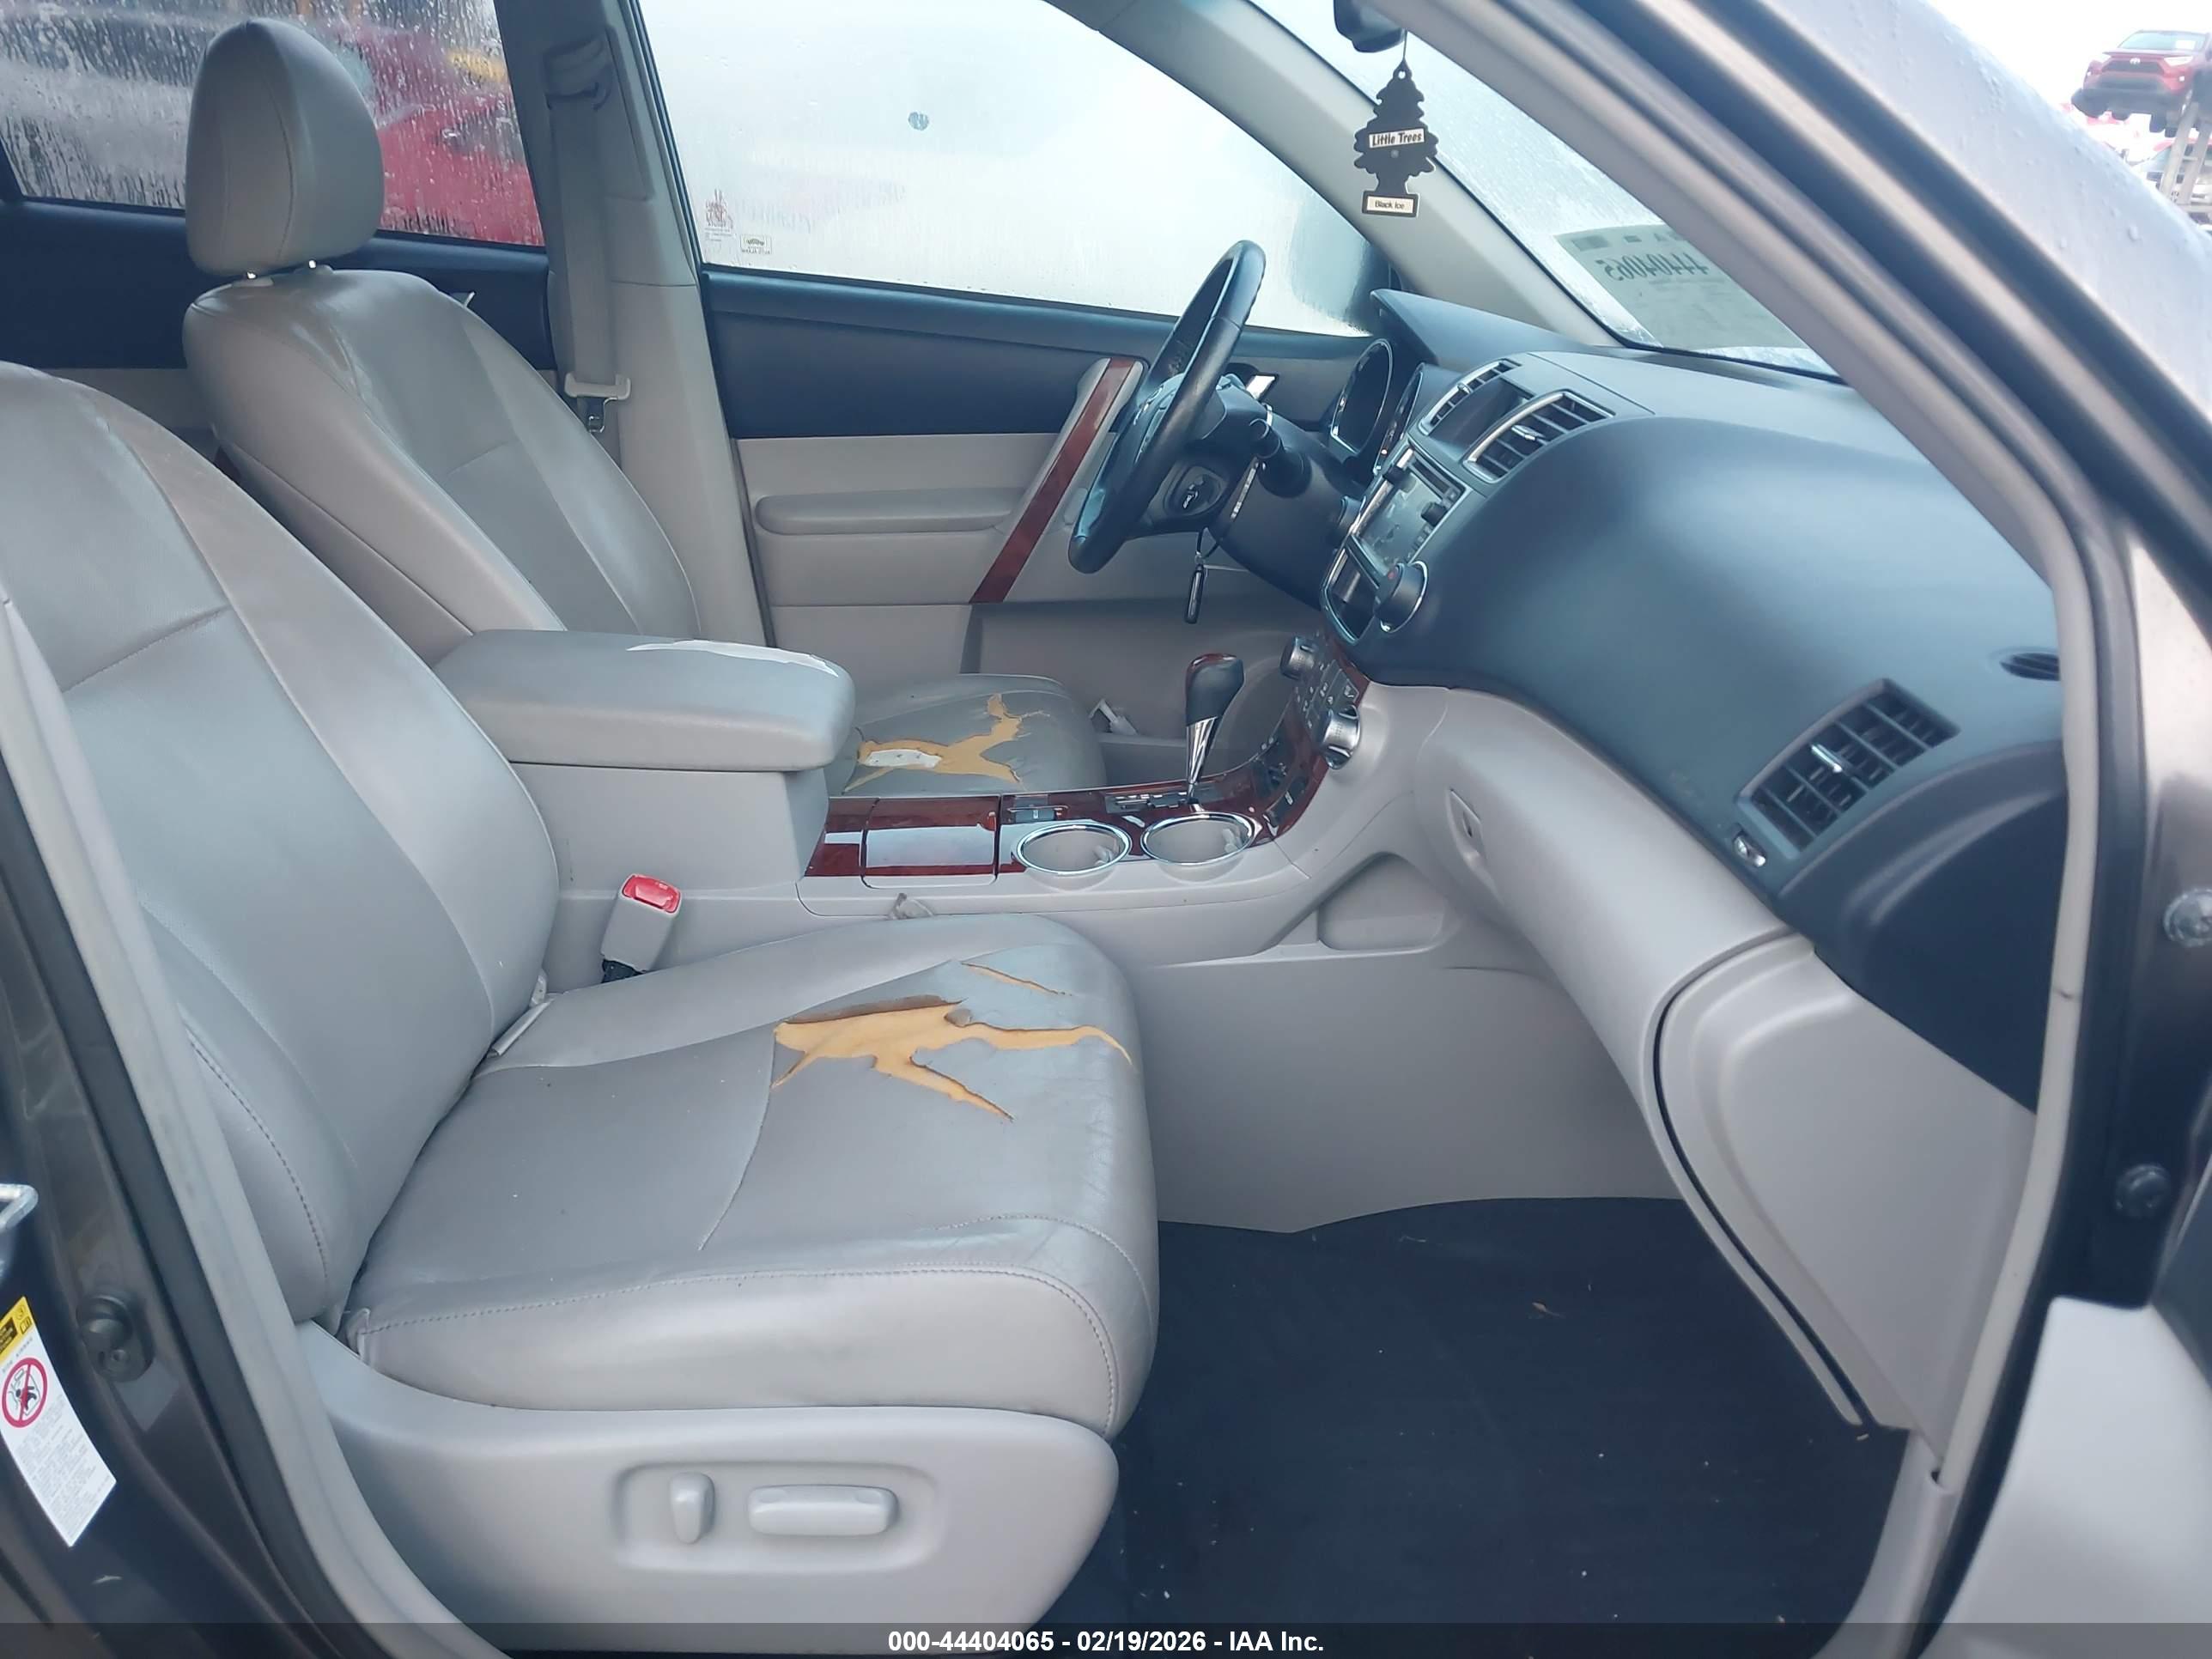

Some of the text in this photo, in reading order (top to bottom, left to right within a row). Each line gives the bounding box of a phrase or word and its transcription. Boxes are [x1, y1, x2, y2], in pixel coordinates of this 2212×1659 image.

[1372, 131, 1422, 147] Little Trees
[1375, 200, 1394, 209] Black
